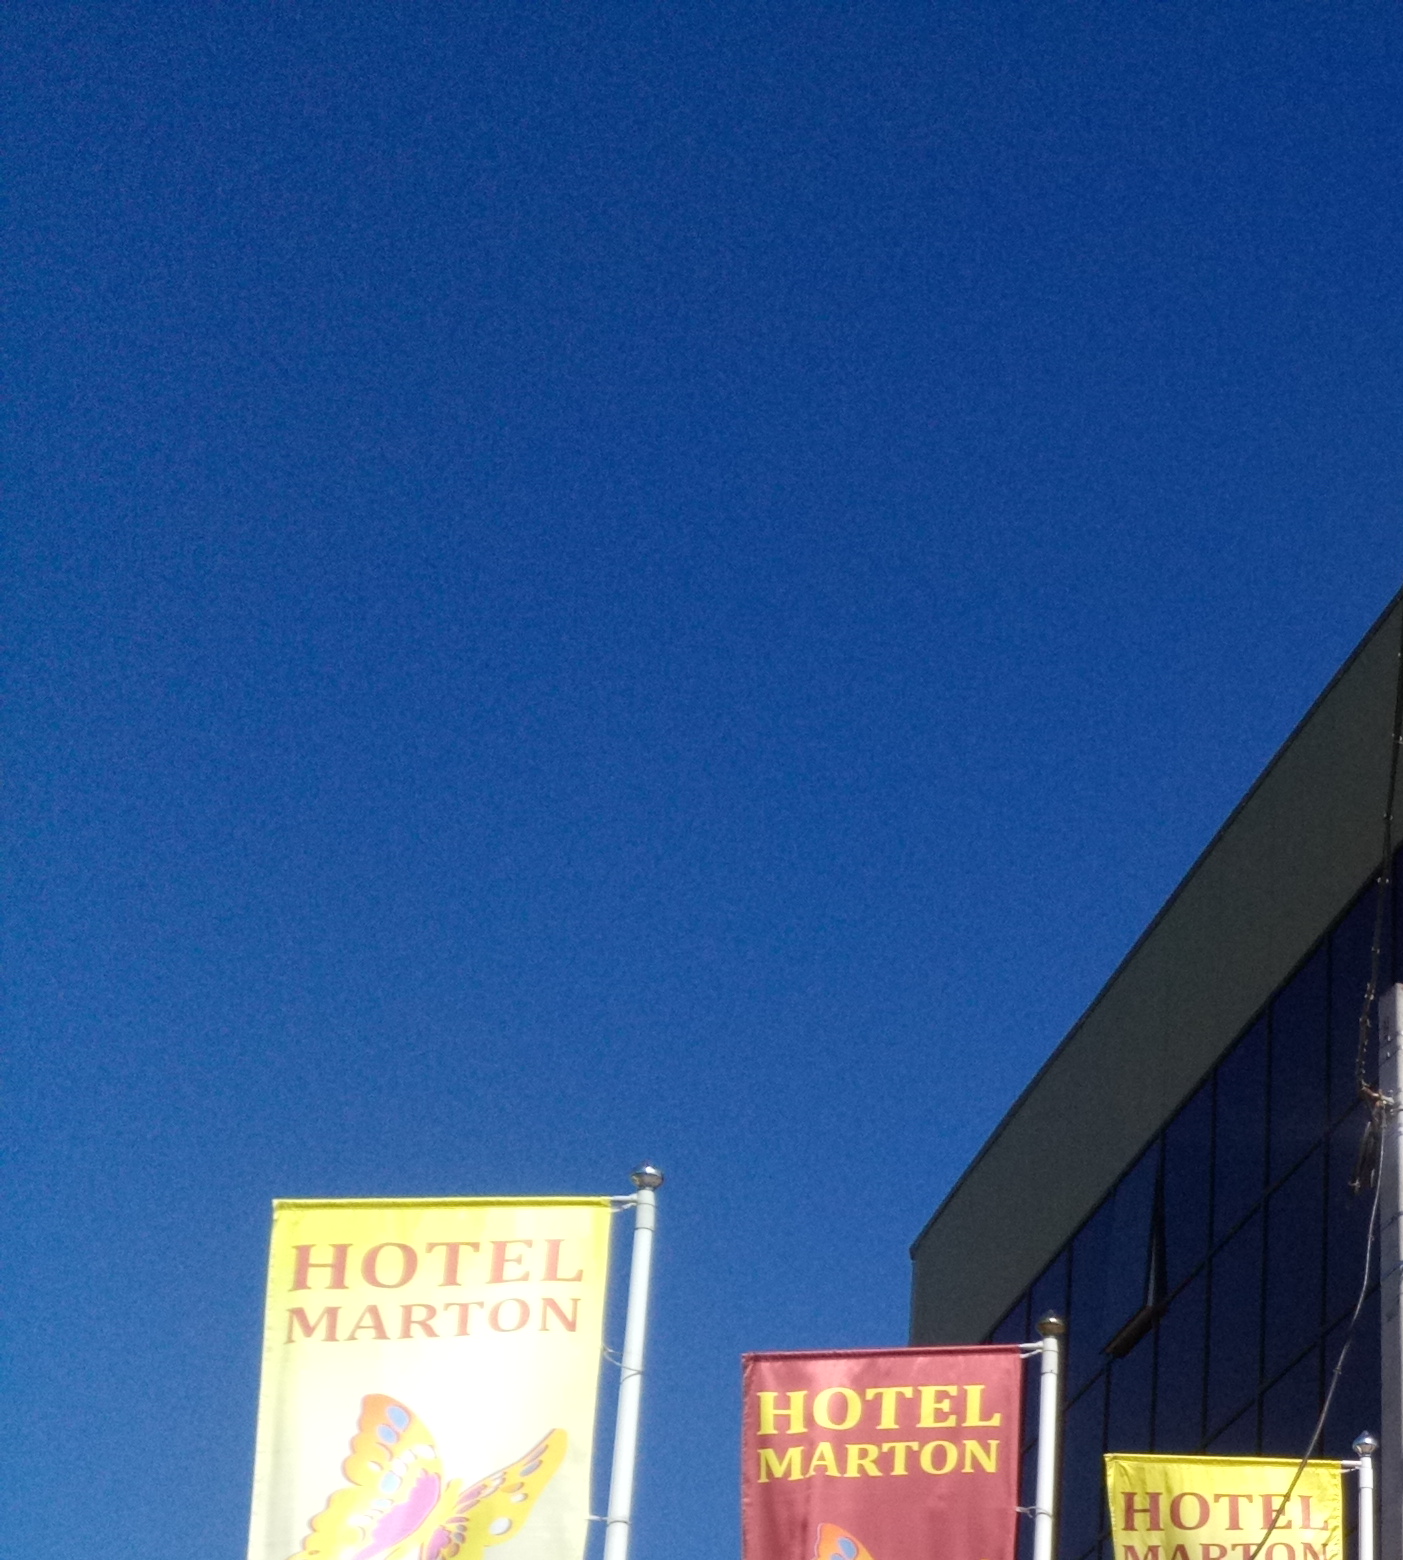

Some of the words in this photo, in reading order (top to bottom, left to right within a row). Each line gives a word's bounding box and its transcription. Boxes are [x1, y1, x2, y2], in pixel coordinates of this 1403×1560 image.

[287, 1237, 584, 1292] HOTEL
[284, 1297, 582, 1344] MARTON
[757, 1384, 1002, 1436] HOTEL
[757, 1439, 999, 1483] MARTON
[1121, 1491, 1329, 1532] HOTEL
